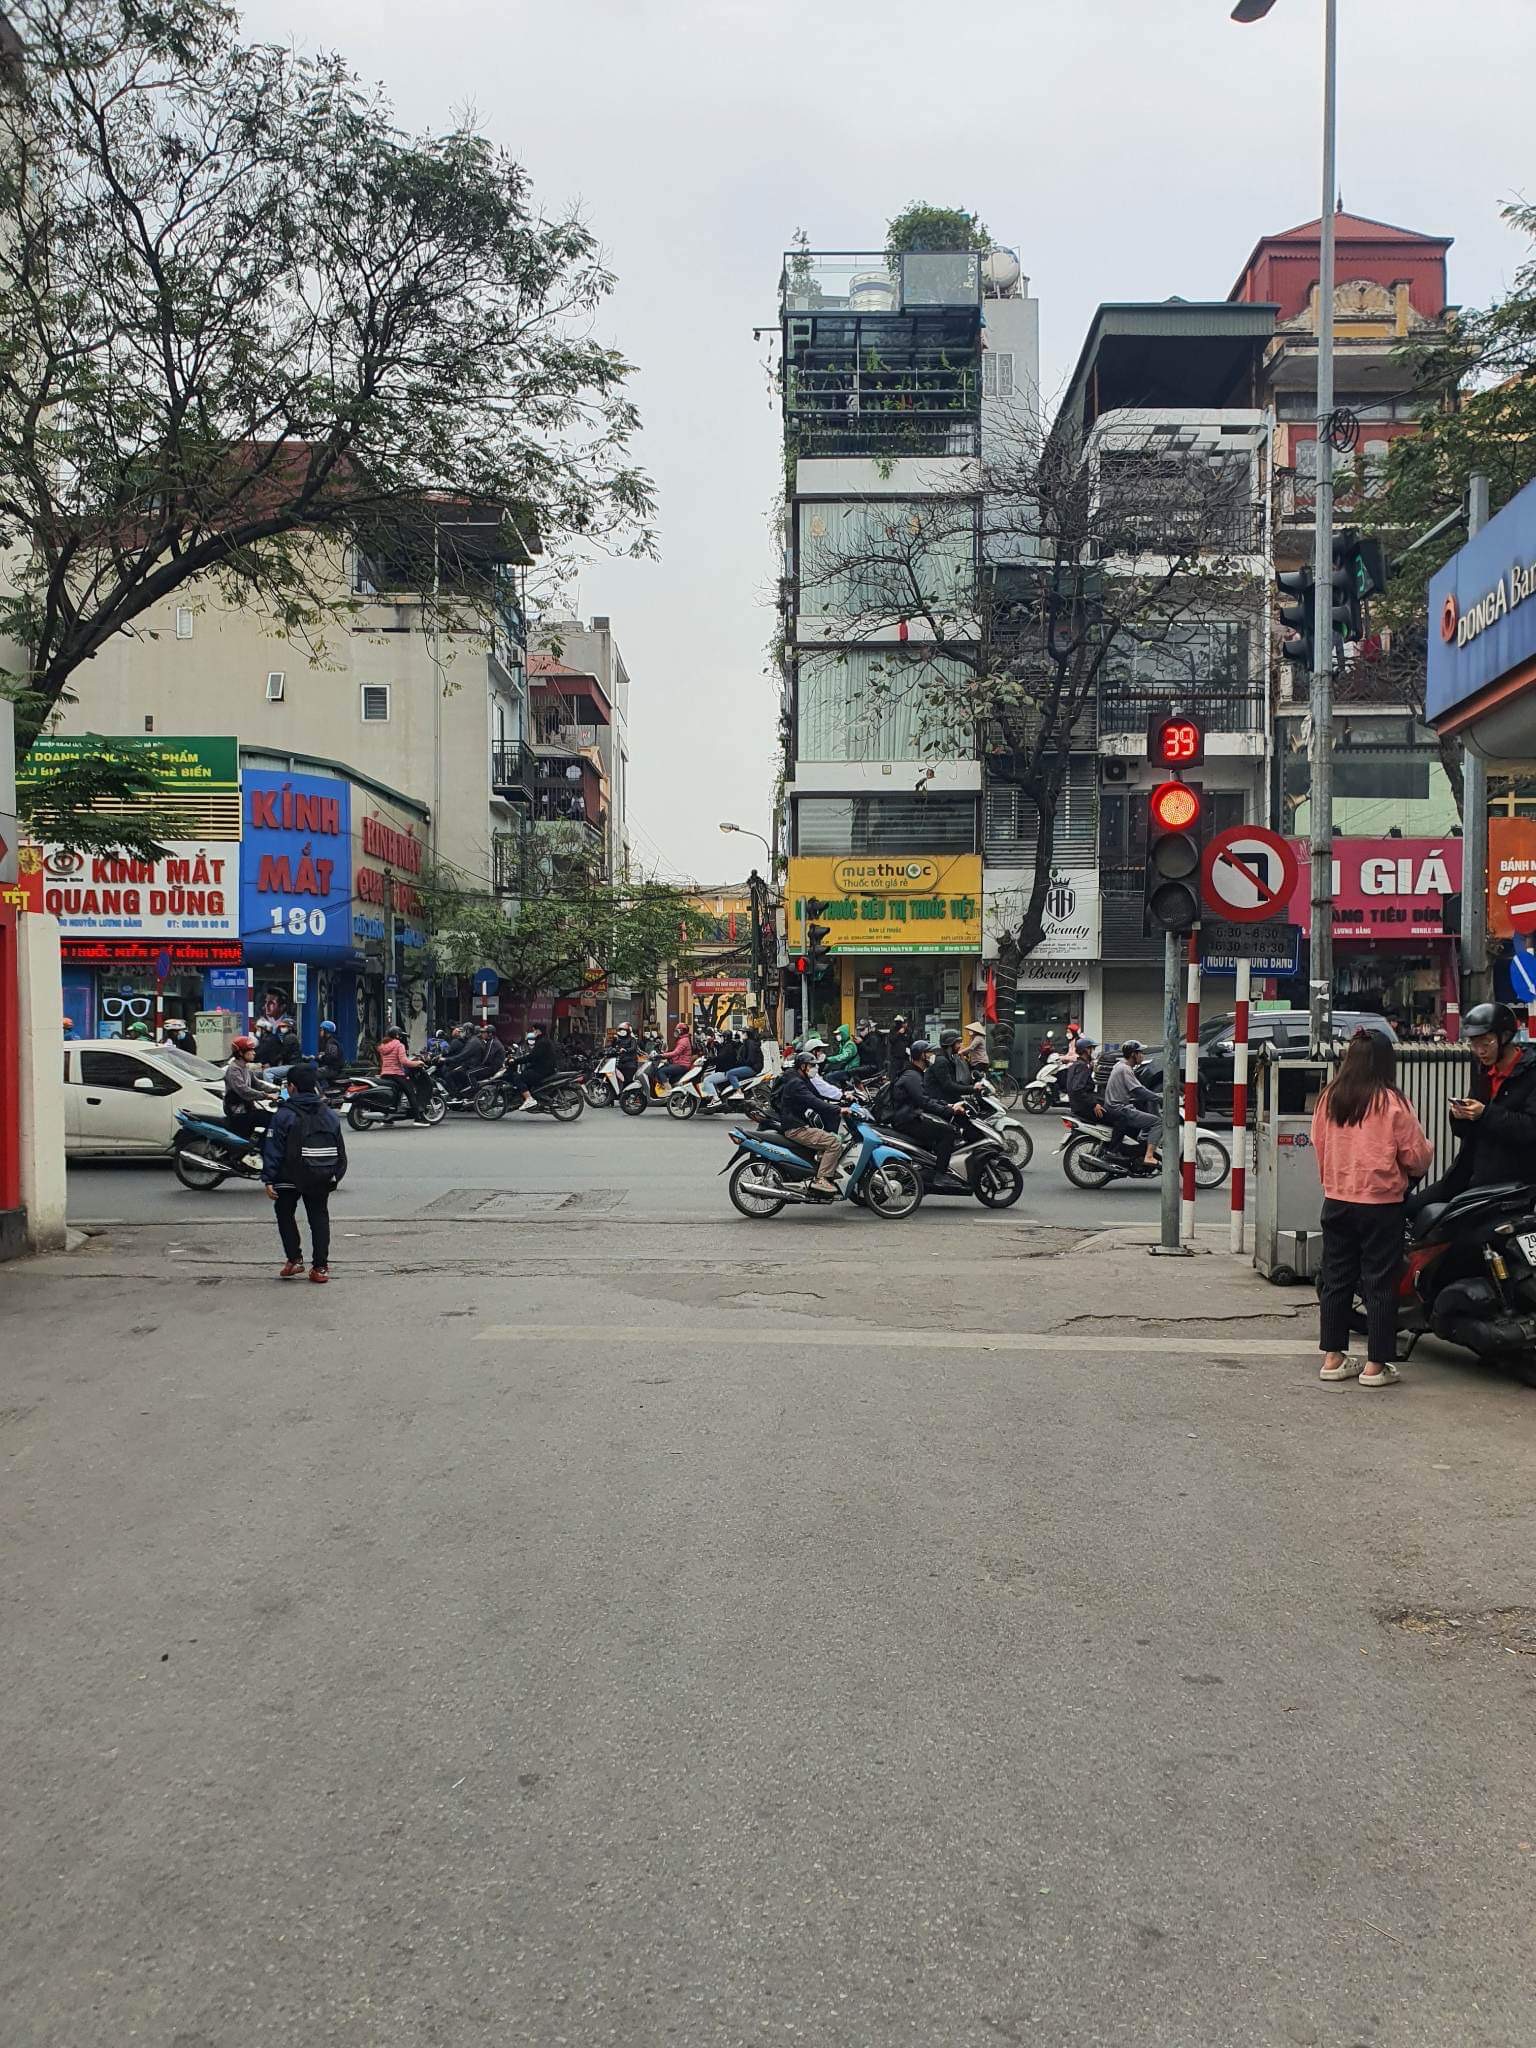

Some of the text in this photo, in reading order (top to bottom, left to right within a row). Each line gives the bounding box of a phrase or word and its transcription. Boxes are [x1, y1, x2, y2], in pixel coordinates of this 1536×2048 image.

[1458, 578, 1507, 647] DONGA
[161, 749, 199, 762] PHẨM
[1165, 727, 1194, 757] 39
[181, 765, 212, 777] BIẾN
[252, 783, 339, 835] KÍNH
[361, 810, 398, 866] KÍNH
[91, 848, 225, 884] KÍNH MẮT
[257, 841, 333, 896] MẮT
[1361, 849, 1453, 895] GIÁ
[1500, 857, 1529, 871] BÁNH
[844, 879, 869, 887] Thuốc
[871, 878, 884, 887] tốt
[885, 880, 897, 888] giá
[46, 886, 225, 916] QUANG DŨNG
[823, 896, 857, 920] HUỐC
[910, 896, 946, 920] THUỐC
[1370, 906, 1407, 923] TIÊU
[270, 907, 326, 936] 180
[1042, 922, 1090, 939] Beauty
[1028, 966, 1081, 984] Beauty
